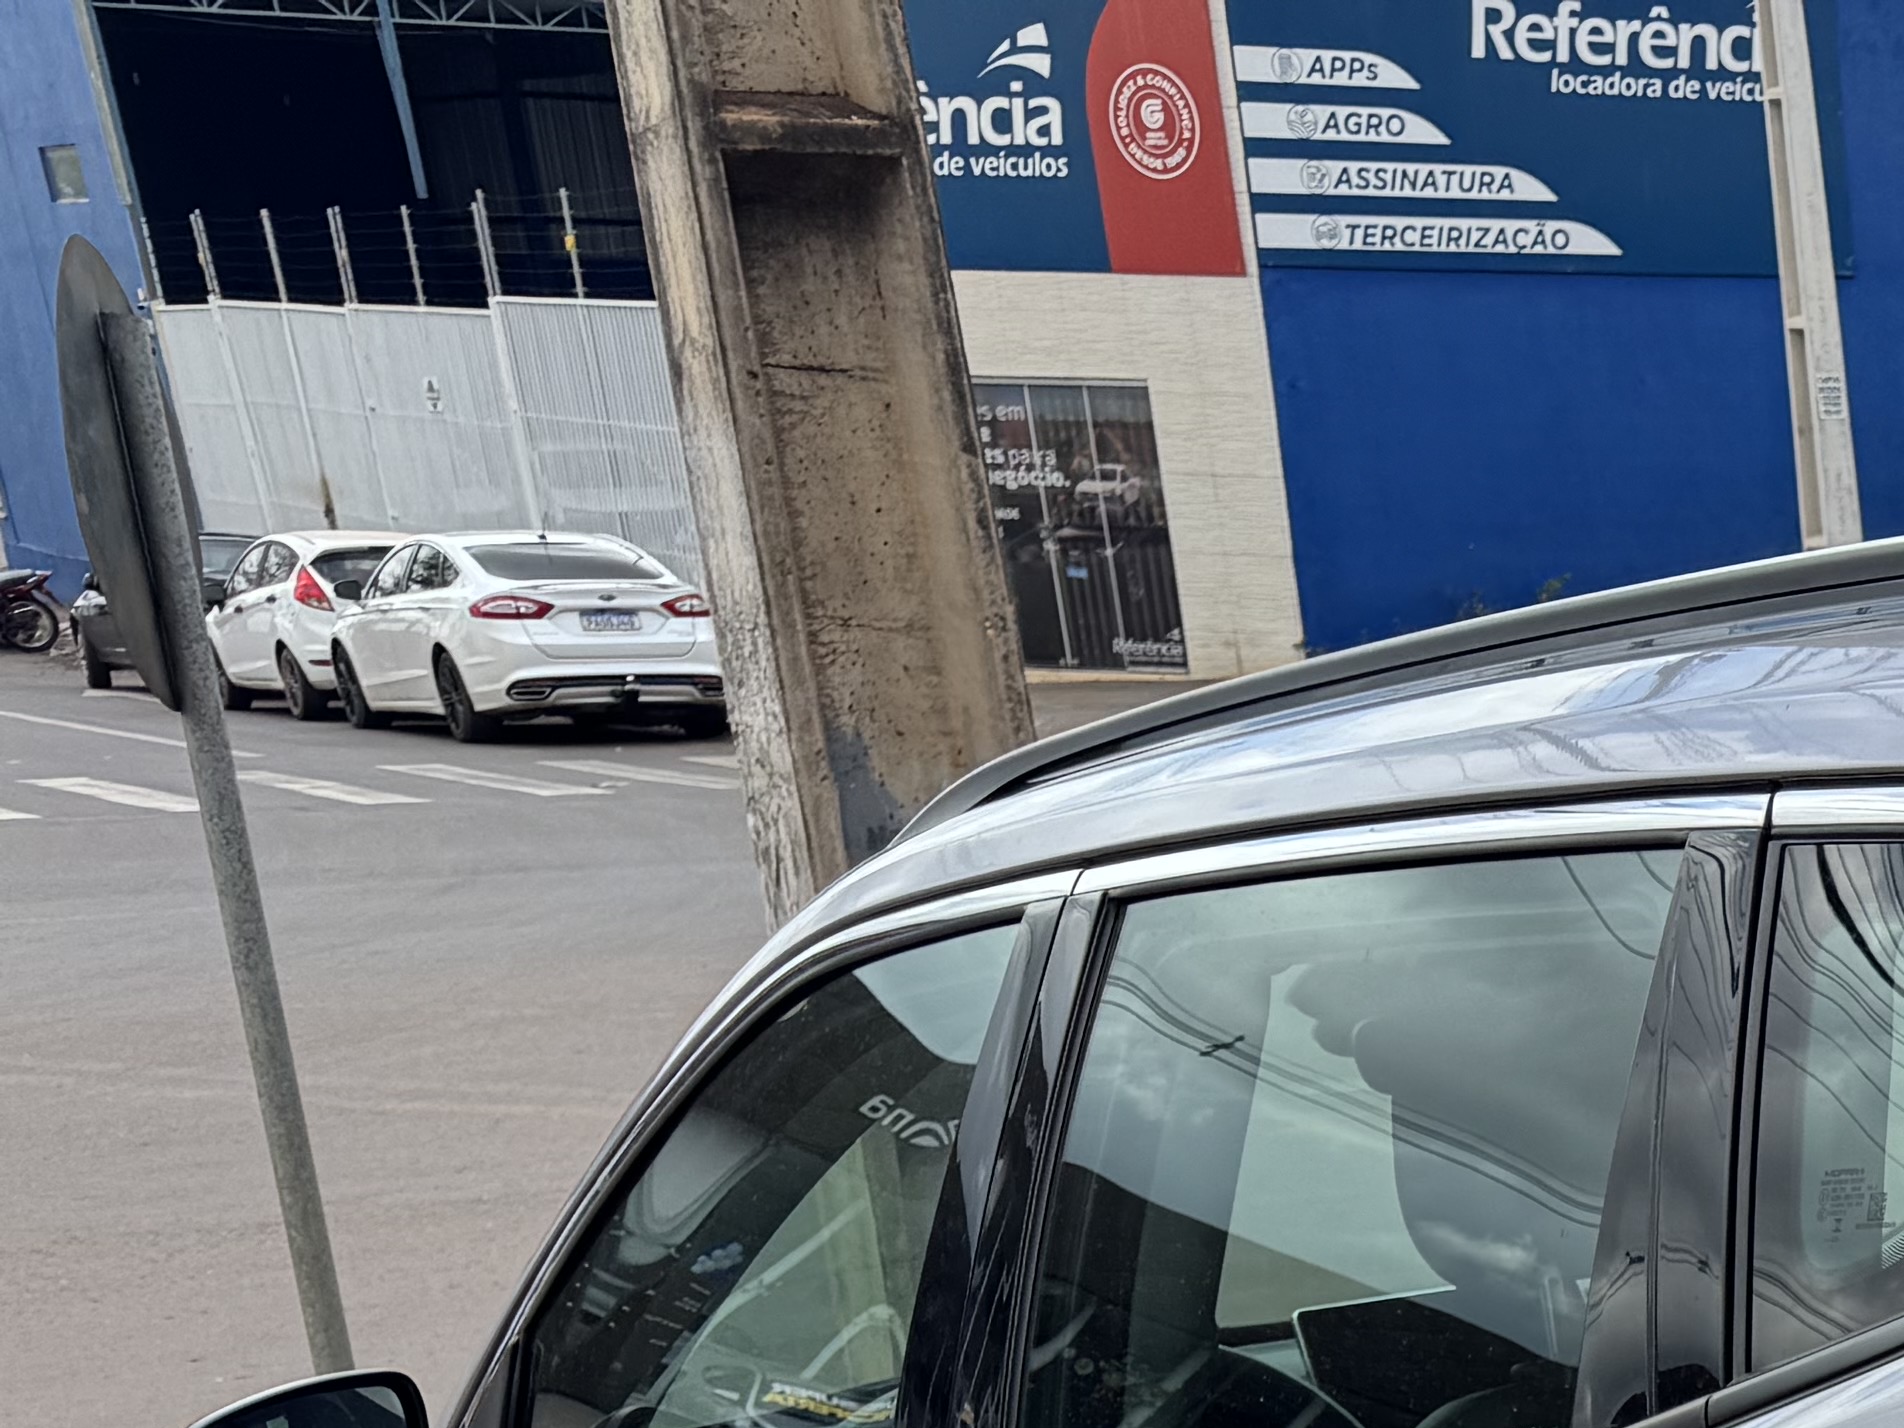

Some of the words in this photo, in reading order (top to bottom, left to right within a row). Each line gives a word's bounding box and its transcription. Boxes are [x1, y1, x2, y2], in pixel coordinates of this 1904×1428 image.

[1471, 0, 1765, 74] Referênci
[1307, 55, 1378, 82] APPs
[1550, 68, 1662, 99] locadora
[1668, 72, 1700, 99] de
[1707, 75, 1765, 103] veícu
[1321, 112, 1405, 138] AGRO
[933, 151, 964, 177] de
[970, 151, 1068, 178] veículos
[1333, 167, 1515, 194] ASSINATURA
[1345, 221, 1571, 252] TERCEIRIZAÇÃO
